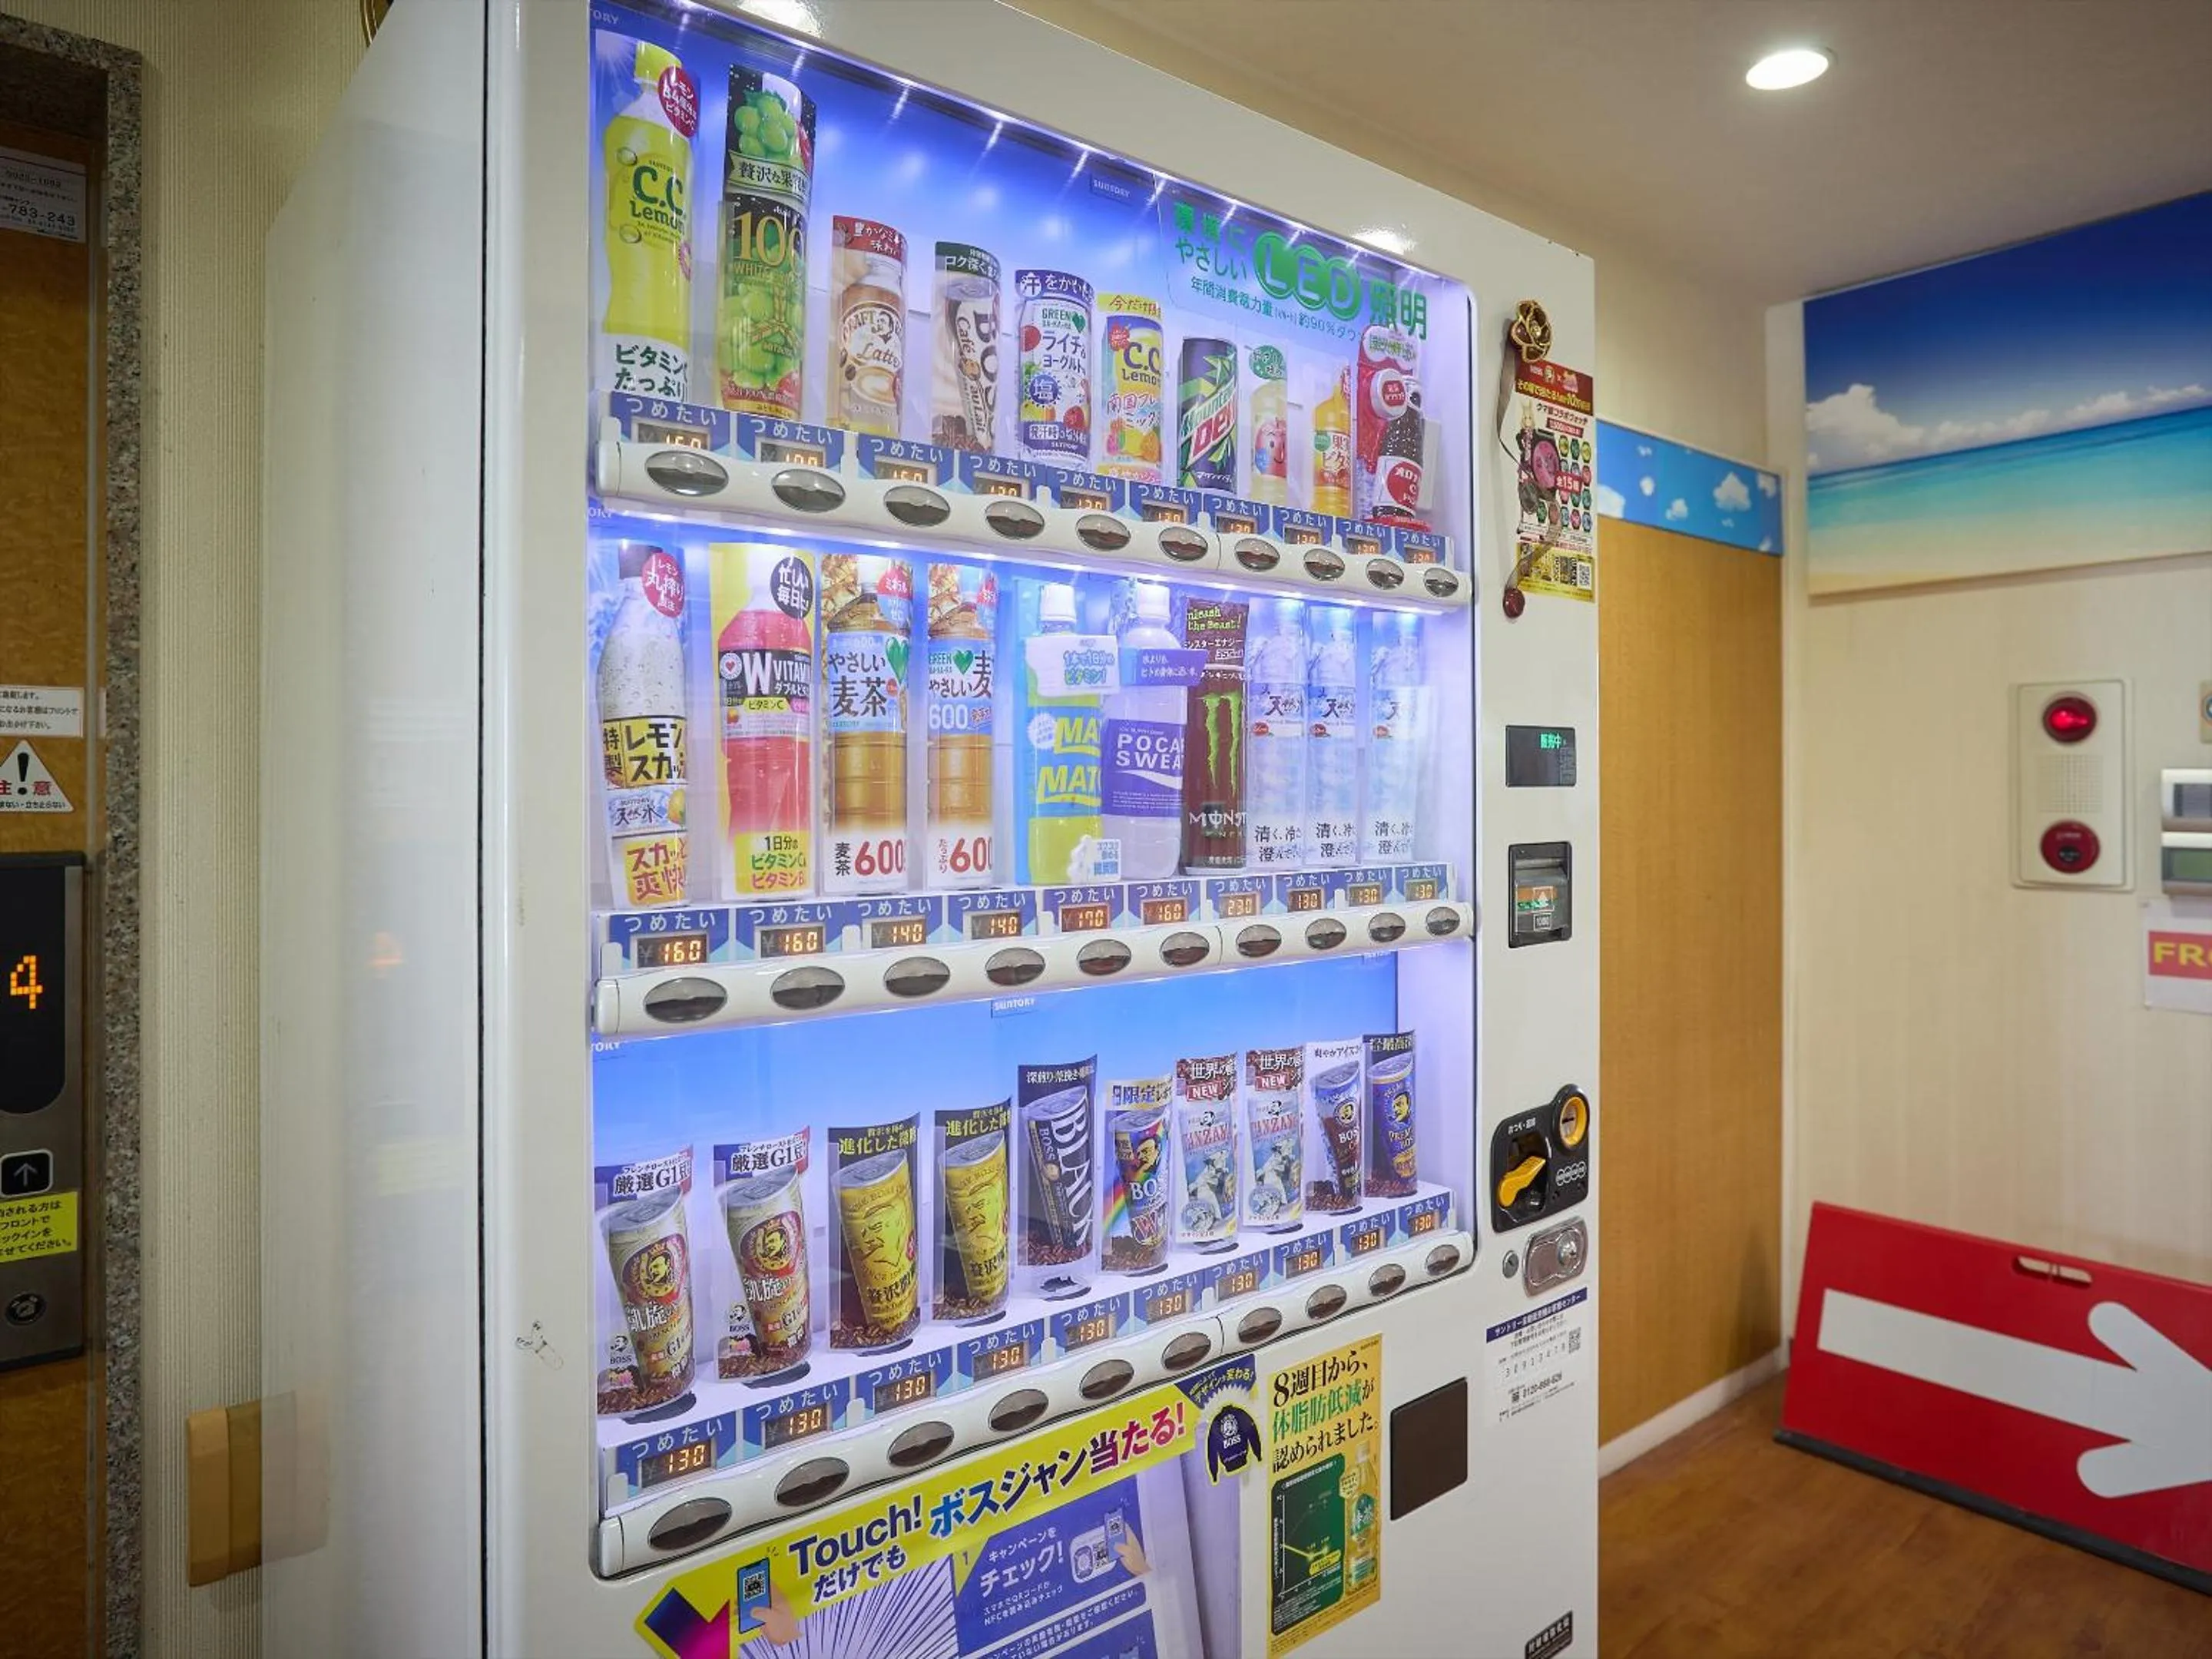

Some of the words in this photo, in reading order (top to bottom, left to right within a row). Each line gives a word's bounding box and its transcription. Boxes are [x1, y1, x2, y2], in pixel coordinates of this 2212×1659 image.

[591, 8, 618, 24] ORY
[1175, 237, 1249, 281] やさしい
[1262, 236, 1355, 306] LED
[614, 343, 687, 376] ビタミン
[627, 396, 717, 426] つめたい
[750, 419, 833, 444] つめたい
[870, 439, 945, 462] つめたい
[969, 455, 1037, 478] つめたい
[1056, 471, 1117, 492] つめたい
[1137, 484, 1194, 505] つめたい
[1212, 498, 1263, 516] つめたい
[1281, 509, 1327, 528] つめたい
[1343, 521, 1386, 538] つめたい
[1399, 531, 1442, 548] つめたい
[828, 651, 886, 674] やさしい
[831, 674, 888, 718] 麦茶
[928, 704, 969, 730] 600
[1117, 733, 1185, 752] POCA
[1115, 750, 1184, 770] SWEA
[835, 841, 852, 877] 麦茶
[1283, 873, 1331, 887] つめたい
[1344, 869, 1388, 882] つめたい
[1401, 865, 1442, 879] つめたい
[1054, 887, 1115, 905] つめたい
[1136, 882, 1193, 899] つめたい
[1215, 878, 1267, 892] つめたい
[1357, 888, 1378, 904] 130
[1415, 883, 1433, 899] 130
[857, 899, 932, 917] つめたい
[958, 892, 1027, 910] つめたい
[1227, 898, 1252, 916] 230
[1296, 892, 1318, 909] 130
[624, 912, 717, 934] つめたい
[749, 905, 833, 925] つめたい
[1078, 911, 1104, 928] 170
[1157, 902, 1183, 922] 160
[890, 923, 923, 944] 140
[989, 916, 1018, 935] 140
[662, 940, 702, 964] 160
[783, 932, 818, 953] 160
[2153, 940, 2212, 969] FR
[10, 955, 43, 1009] 4
[591, 1041, 620, 1052] ORY
[1191, 1084, 1220, 1100] NEW
[1260, 1075, 1286, 1088] NEW
[1405, 1196, 1445, 1217] つめたい
[1347, 1214, 1391, 1237] つめたい
[1412, 1214, 1432, 1231] 130
[1280, 1233, 1329, 1257] つめたい
[1358, 1233, 1378, 1251] 130
[1211, 1254, 1264, 1279] つめたい
[1296, 1252, 1320, 1272] 130
[1142, 1273, 1197, 1299] つめたい
[1228, 1272, 1253, 1293] 130
[1061, 1296, 1121, 1326] つめたい
[1157, 1296, 1183, 1317] 130
[968, 1323, 1036, 1355] つめたい
[1078, 1319, 1105, 1343] 130
[868, 1351, 943, 1386] つめたい
[992, 1346, 1021, 1371] 130
[895, 1375, 926, 1402] 130
[1273, 1349, 1370, 1409] 8週目から、
[756, 1383, 839, 1420] つめたい
[1272, 1374, 1375, 1445] 体脂肪低減が
[788, 1408, 823, 1436] 130
[631, 1417, 722, 1459] つめたい
[1272, 1412, 1380, 1475] 認められました。
[668, 1442, 707, 1475] 130
[929, 1401, 1187, 1538] ボスジャン当たる!
[788, 1494, 924, 1577] Touch!
[988, 1525, 1058, 1564] キャンペーンを
[813, 1544, 907, 1604] だけでも
[980, 1543, 1065, 1598] チェック!
